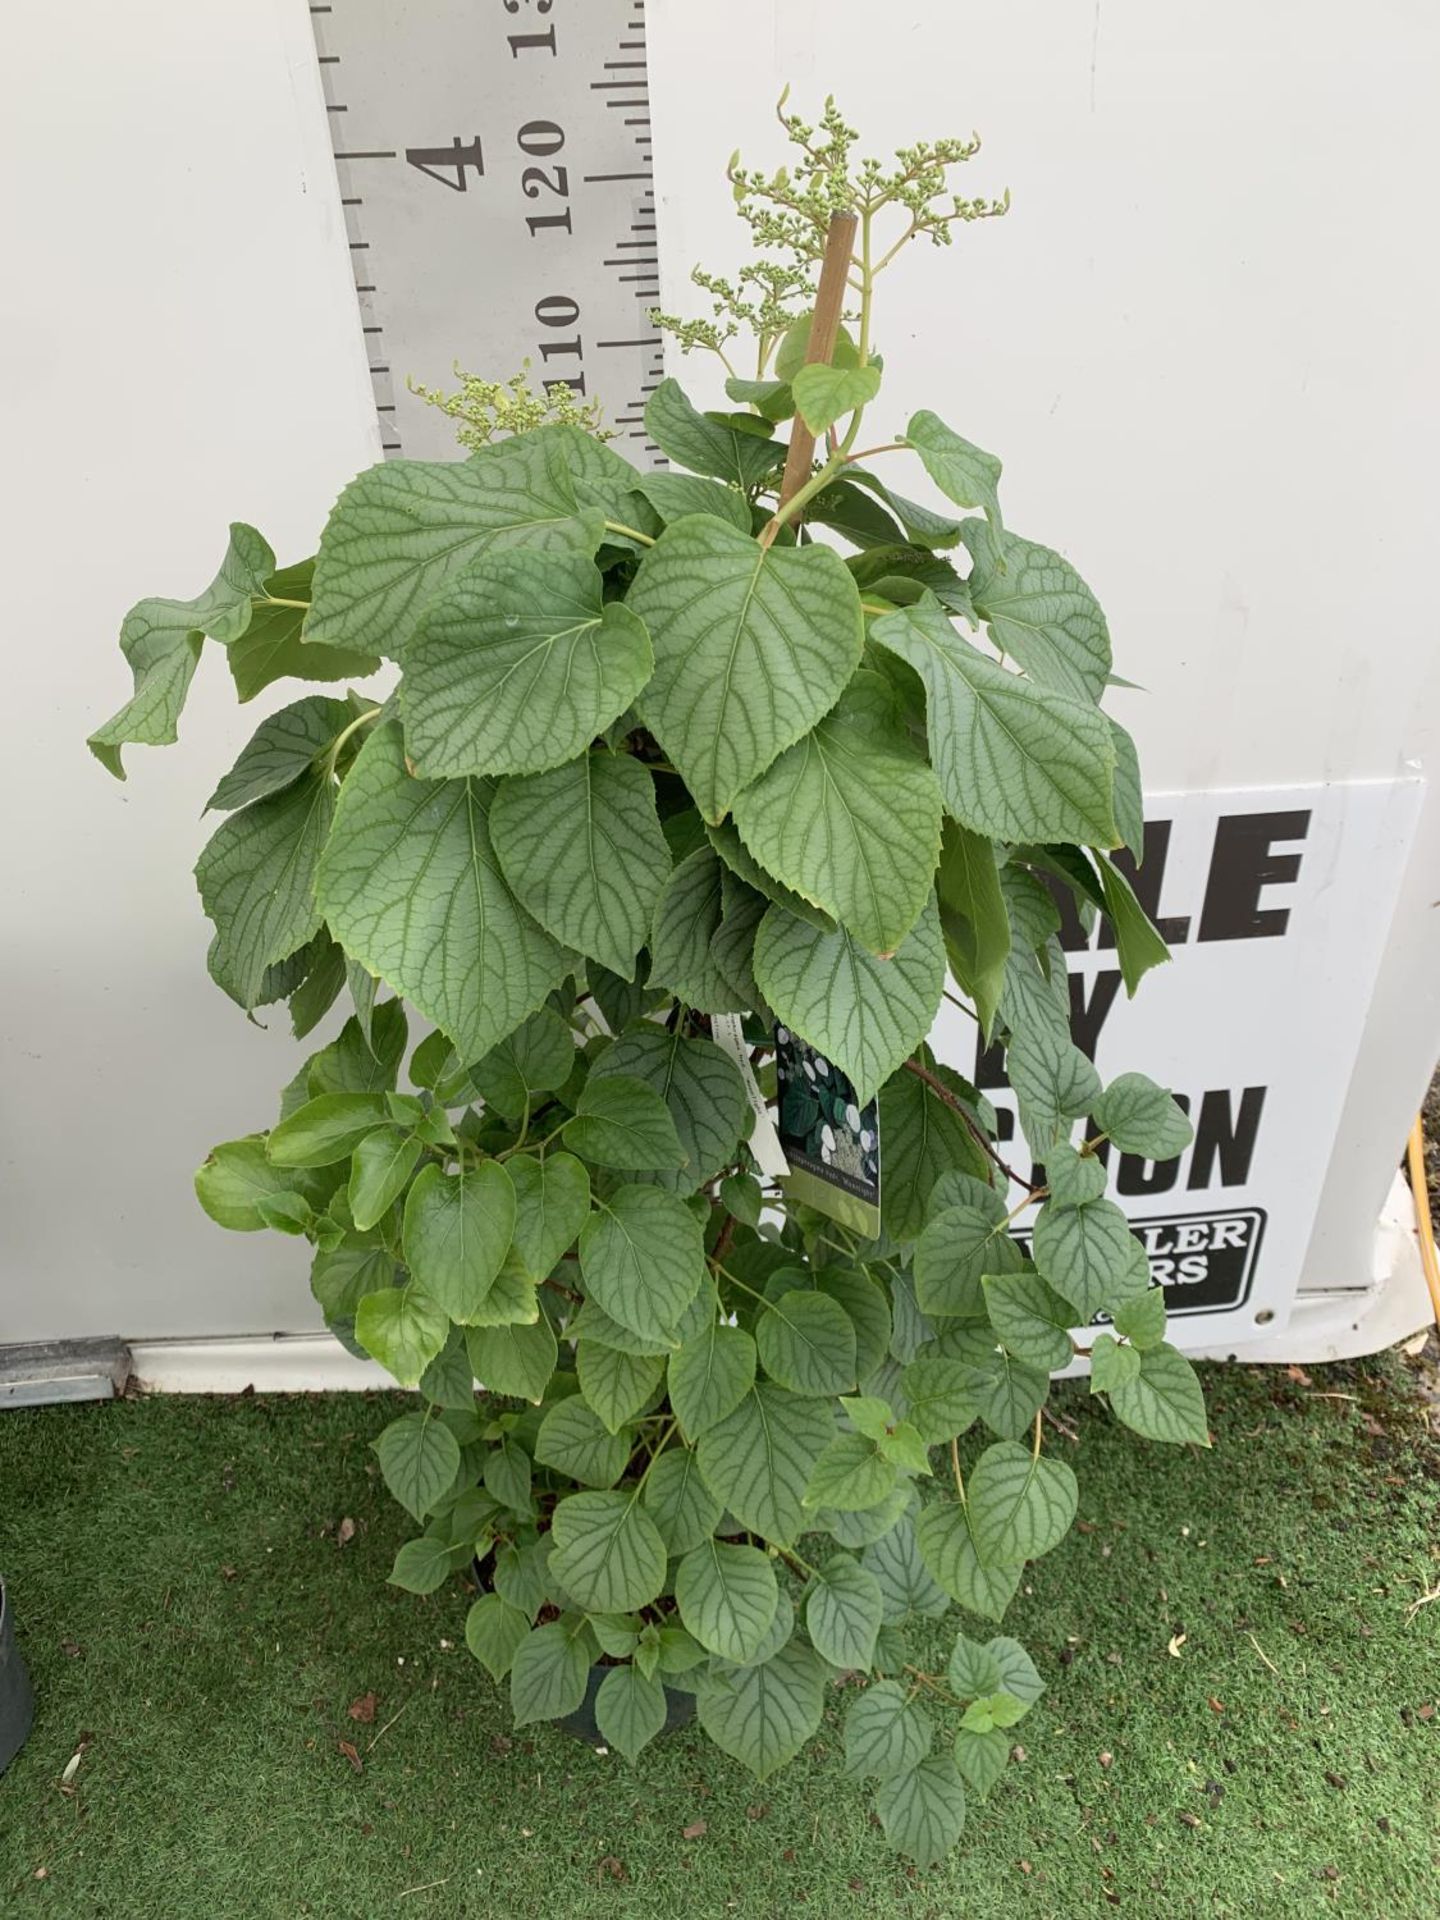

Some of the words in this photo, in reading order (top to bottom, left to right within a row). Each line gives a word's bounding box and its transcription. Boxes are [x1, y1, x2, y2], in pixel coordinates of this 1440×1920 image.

[405, 135, 485, 193] 4
[516, 119, 573, 238] 120
[534, 295, 586, 397] 110
